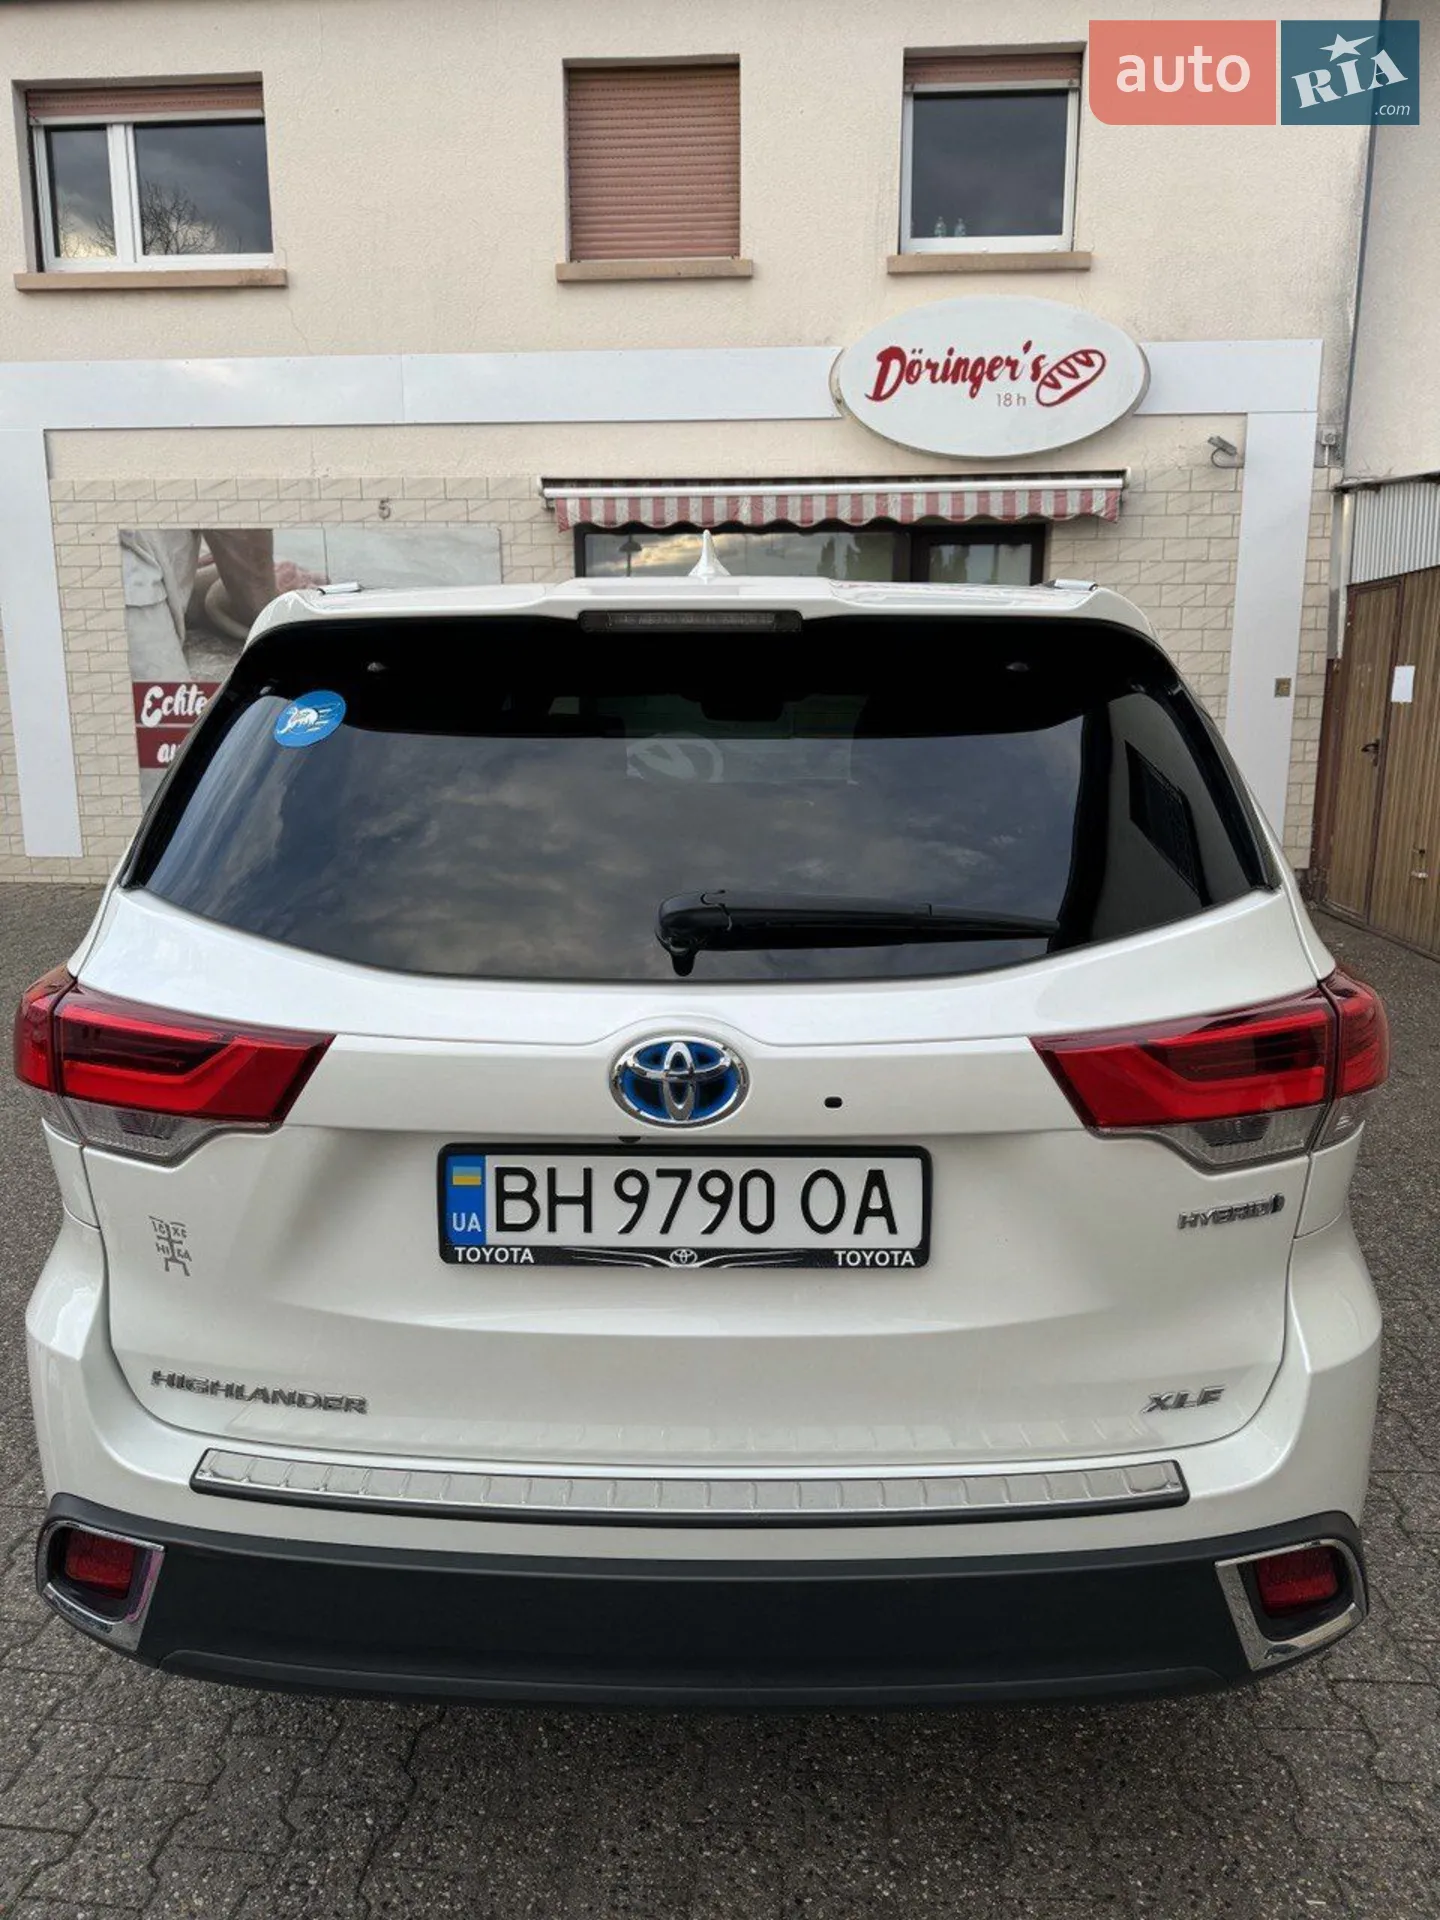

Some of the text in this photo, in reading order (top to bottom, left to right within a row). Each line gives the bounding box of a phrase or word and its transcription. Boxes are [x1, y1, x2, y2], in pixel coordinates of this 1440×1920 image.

[864, 340, 1046, 402] Döringer's
[378, 497, 391, 520] 5
[141, 683, 208, 728] Echte
[495, 1166, 899, 1235] BH 9790 OA
[1178, 1199, 1274, 1230] HYBRID
[452, 1211, 482, 1233] UA
[454, 1246, 535, 1265] TOYOTA
[834, 1249, 916, 1268] TOYOTA
[151, 1369, 368, 1415] HIGHLANDER
[1140, 1384, 1226, 1414] XLE
